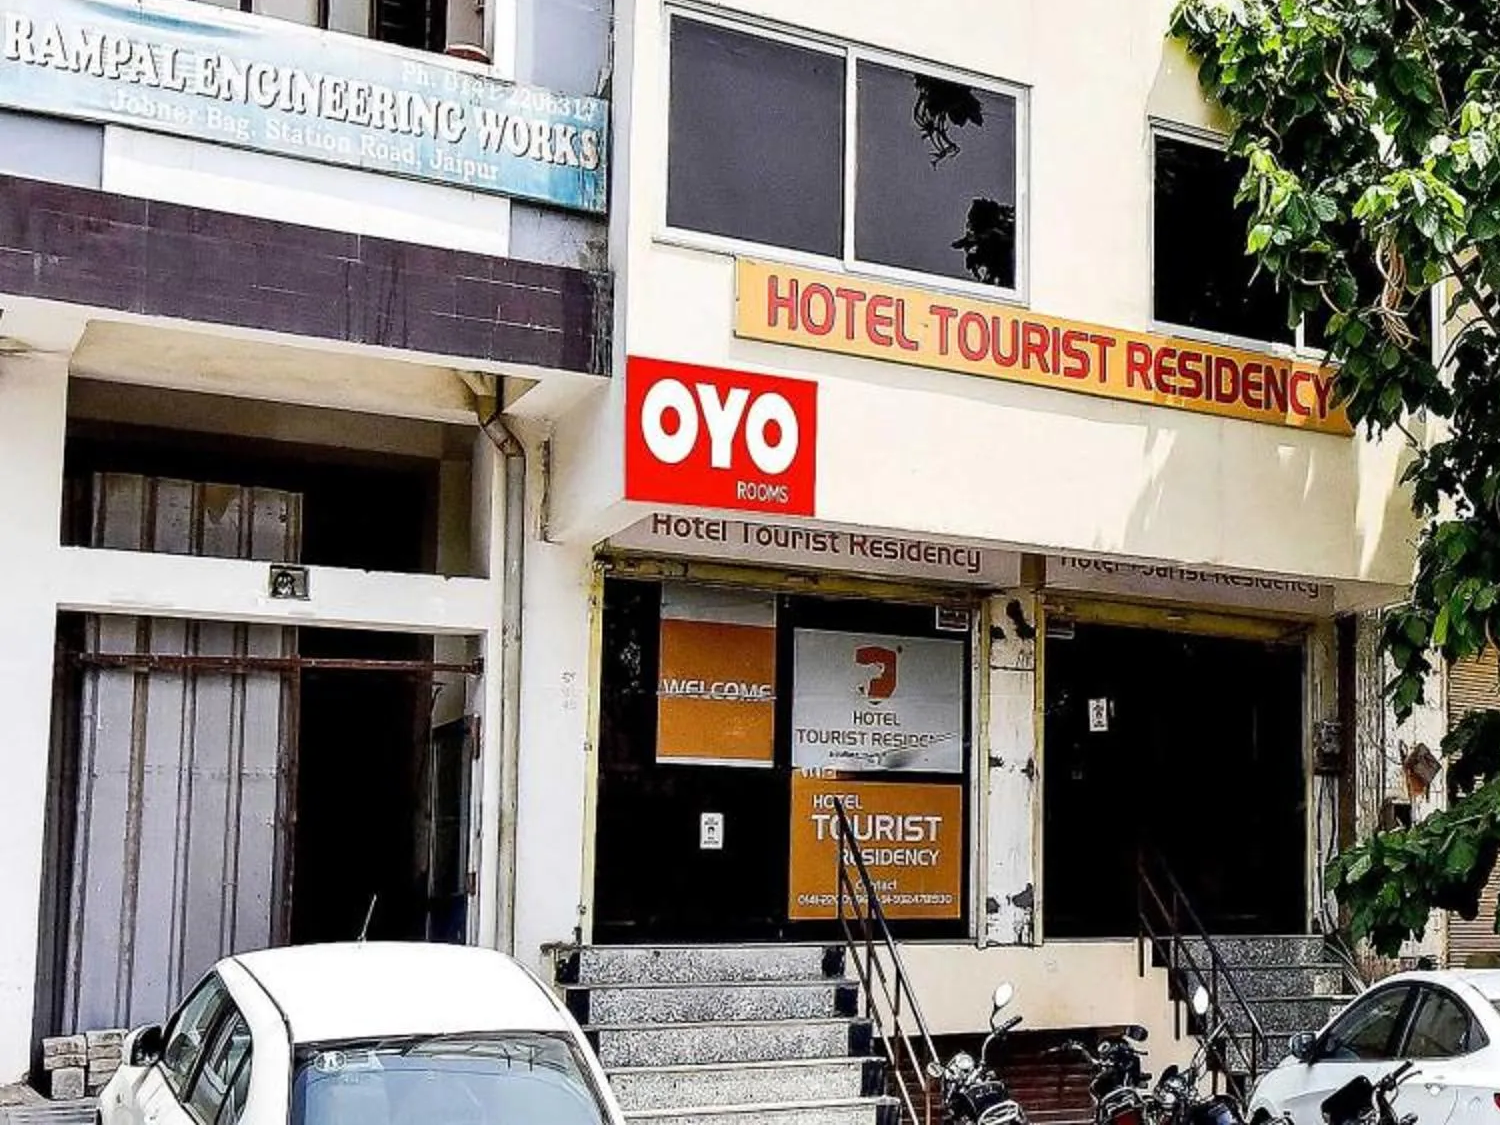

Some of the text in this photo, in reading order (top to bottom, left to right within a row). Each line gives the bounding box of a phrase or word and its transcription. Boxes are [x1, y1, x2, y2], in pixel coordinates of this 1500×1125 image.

[5, 11, 600, 170] RAMPAL ENGINEERING WORKS
[110, 88, 196, 125] Jobner
[266, 120, 352, 154] Station
[430, 147, 499, 182] Jaipur
[767, 275, 1336, 420] HOTEL TOURIST RESIDENCY
[641, 378, 799, 476] OYO
[737, 481, 789, 504] ROOMS
[652, 512, 982, 574] Hotel Tourist Residency
[663, 678, 772, 702] WELCOME
[853, 710, 901, 726] HOTEL
[795, 728, 867, 746] TOURIST
